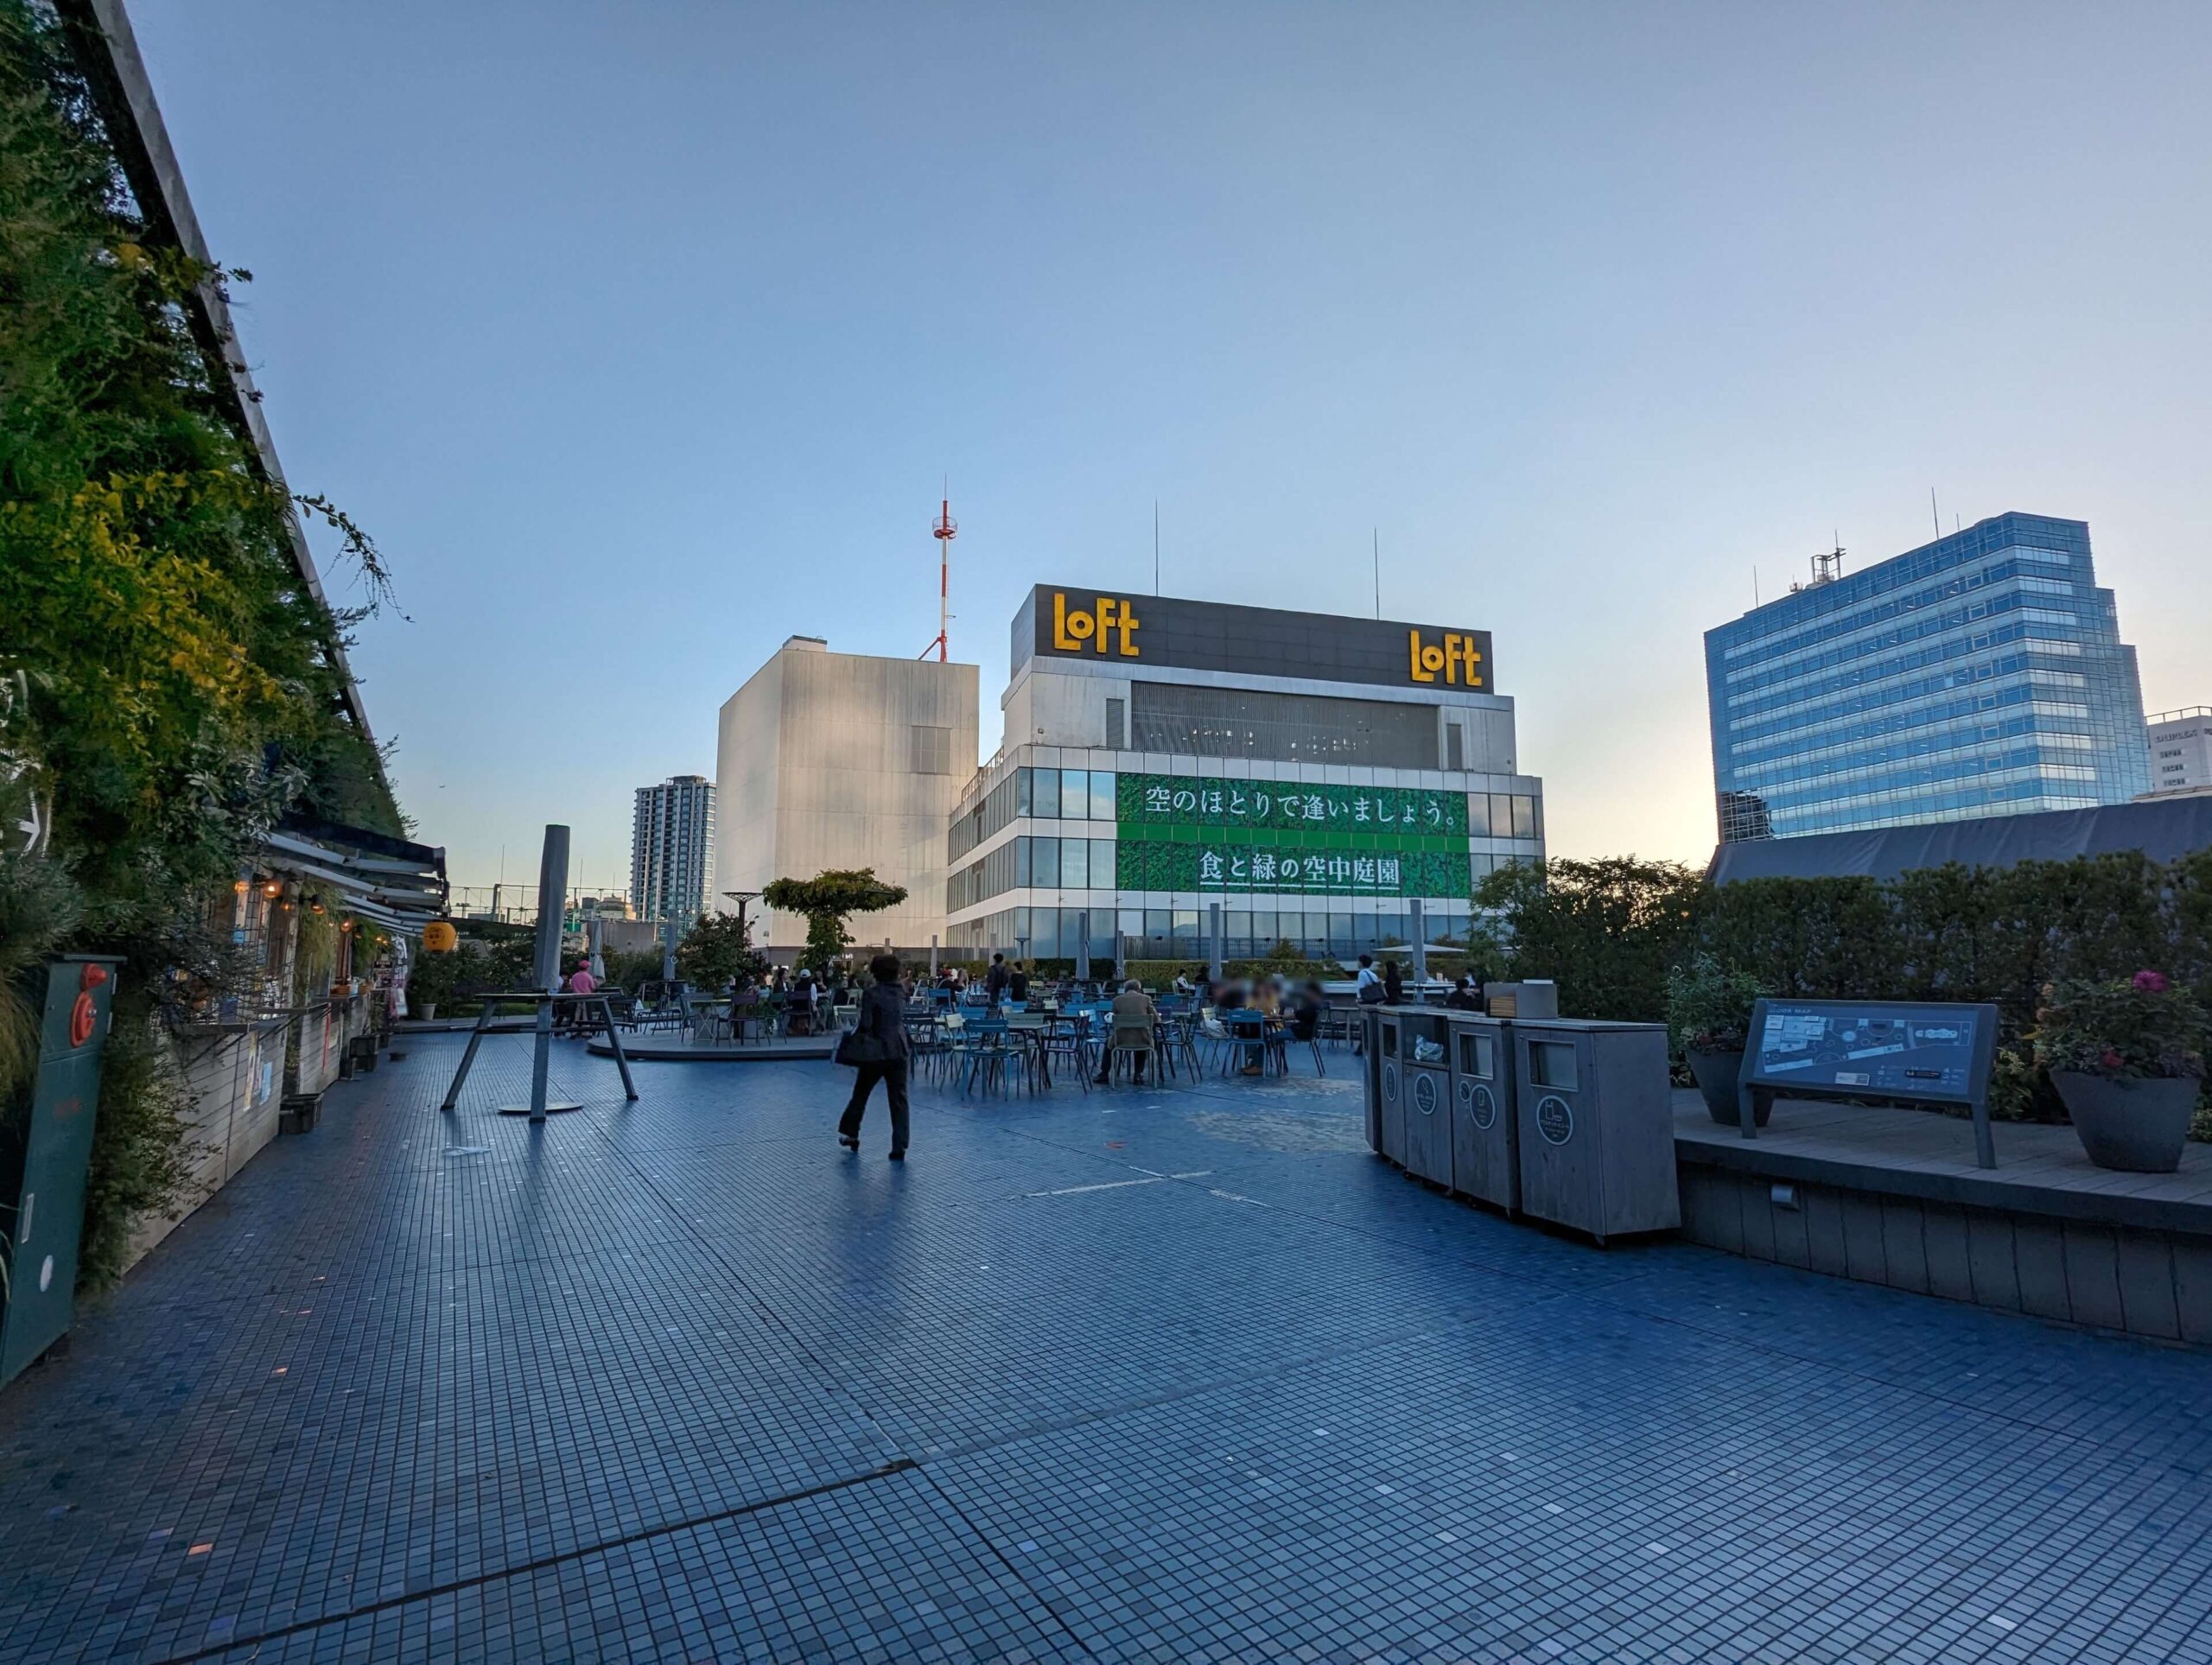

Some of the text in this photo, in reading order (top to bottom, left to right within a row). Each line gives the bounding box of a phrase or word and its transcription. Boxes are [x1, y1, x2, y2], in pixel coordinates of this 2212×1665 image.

[1146, 786, 1455, 827] 空のほとりで逢いましょう。
[1199, 851, 1400, 885] 食と緑の空中庭園
